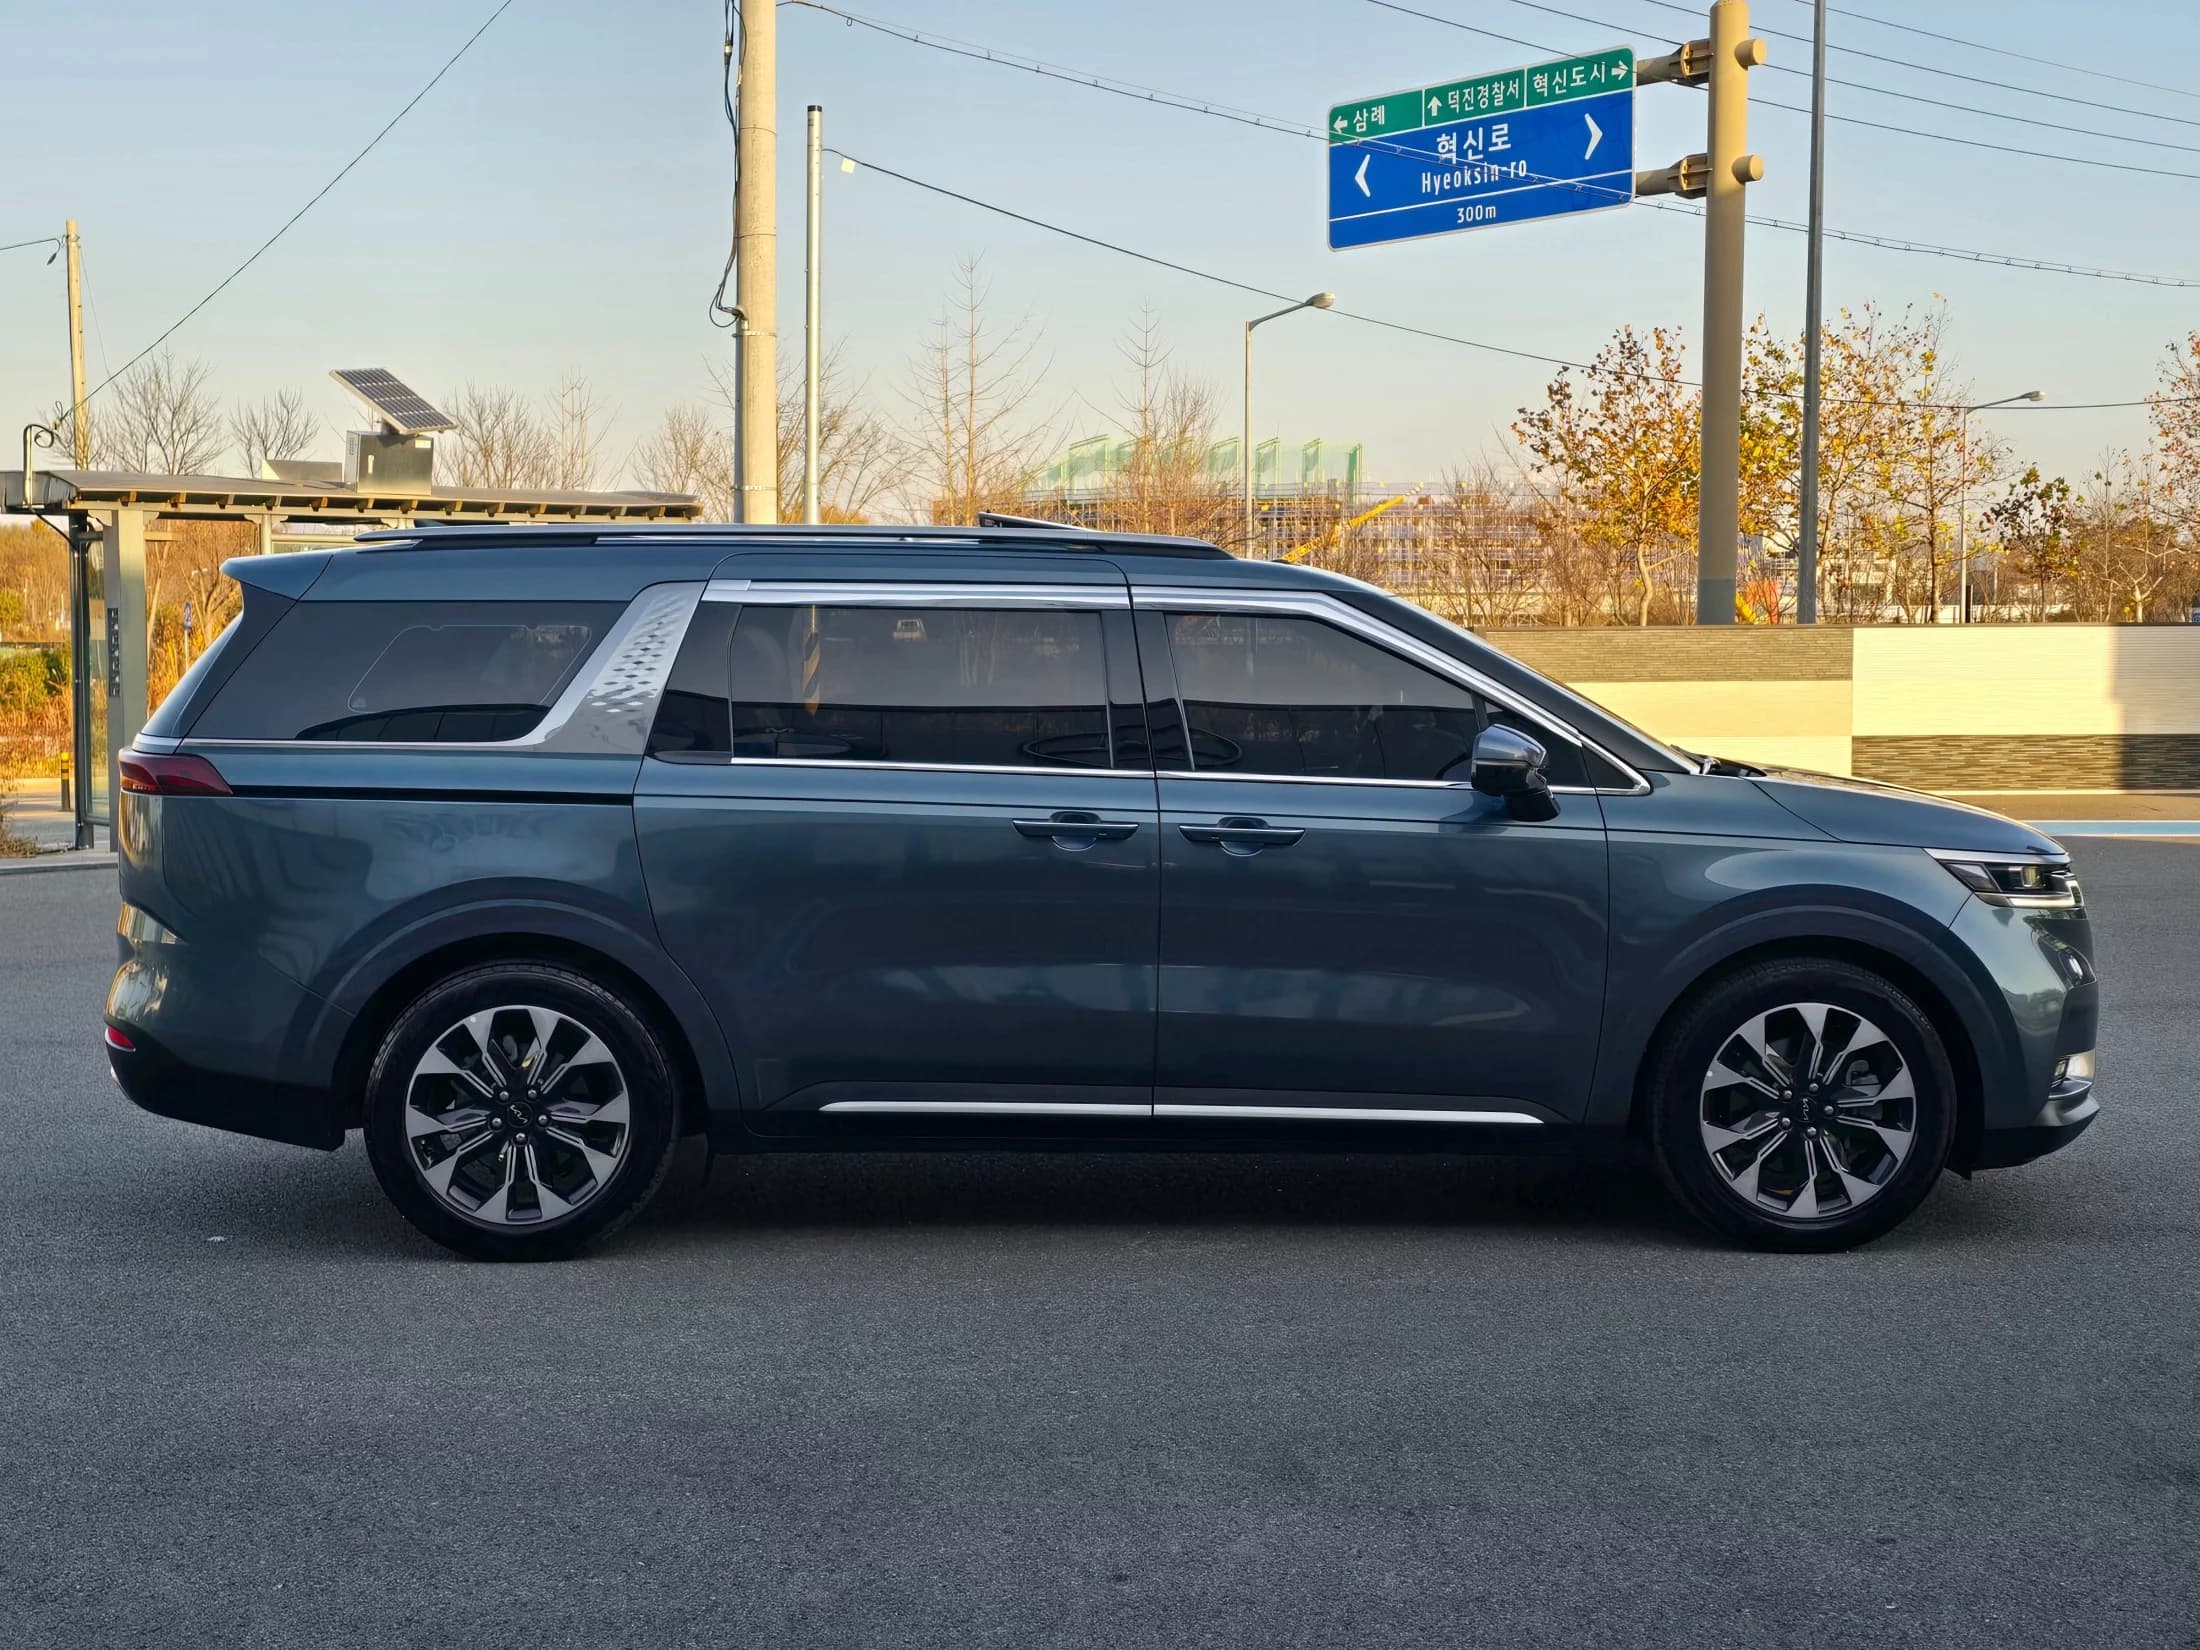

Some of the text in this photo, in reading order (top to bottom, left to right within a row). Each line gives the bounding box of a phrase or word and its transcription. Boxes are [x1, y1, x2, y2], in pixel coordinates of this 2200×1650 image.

[1448, 78, 1519, 113] 덕진경찰서
[1532, 62, 1606, 97] 혁신도시
[1353, 104, 1385, 132] 삼례
[1436, 123, 1512, 165] 혁신로
[1421, 160, 1527, 196] Hyeoksin-ro
[1457, 205, 1496, 223] 300m
